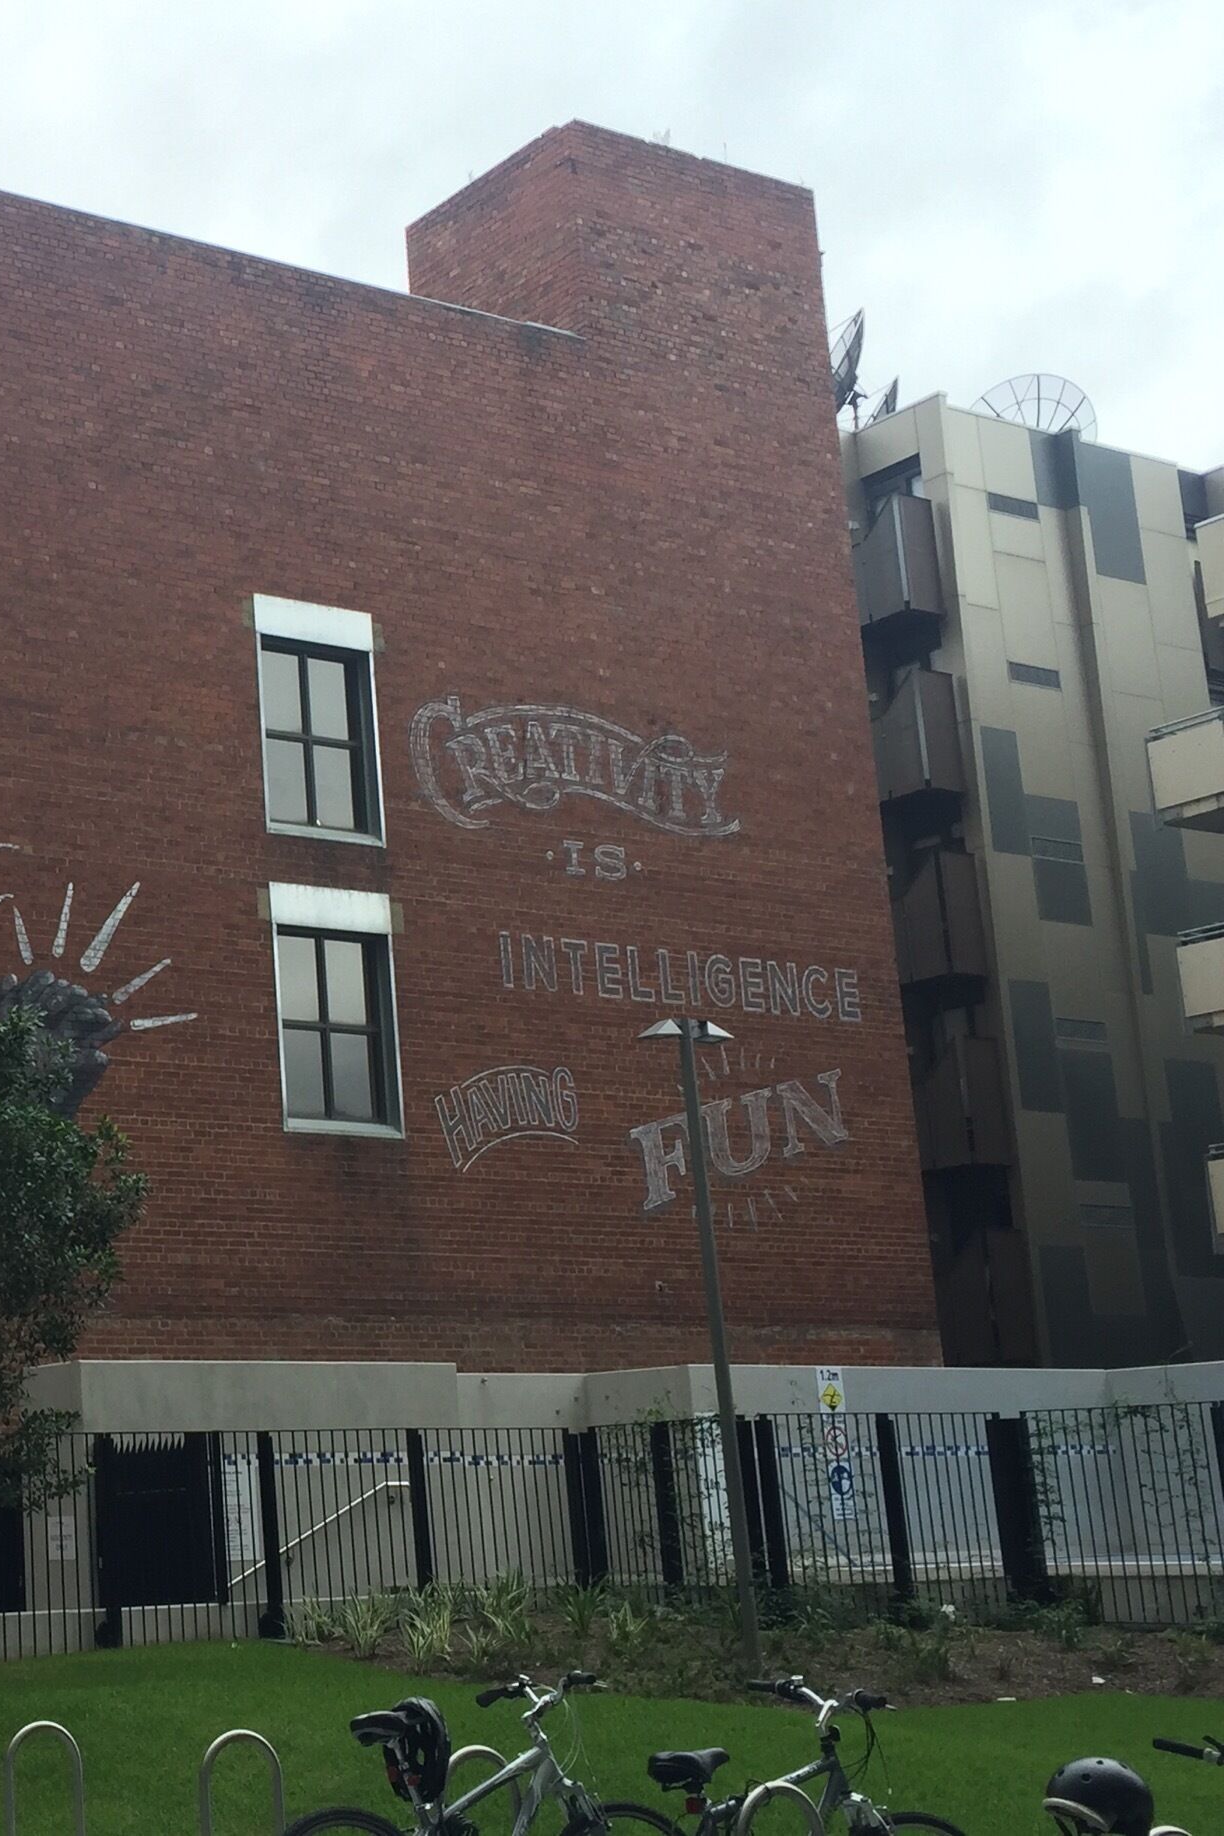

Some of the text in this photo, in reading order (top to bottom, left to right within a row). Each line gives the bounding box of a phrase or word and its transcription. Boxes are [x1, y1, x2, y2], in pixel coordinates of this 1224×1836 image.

[409, 695, 740, 836] CREATIVITY
[498, 931, 862, 1022] INTELLIGENCE
[434, 1066, 579, 1168] HAVING
[629, 1068, 848, 1210] FUN
